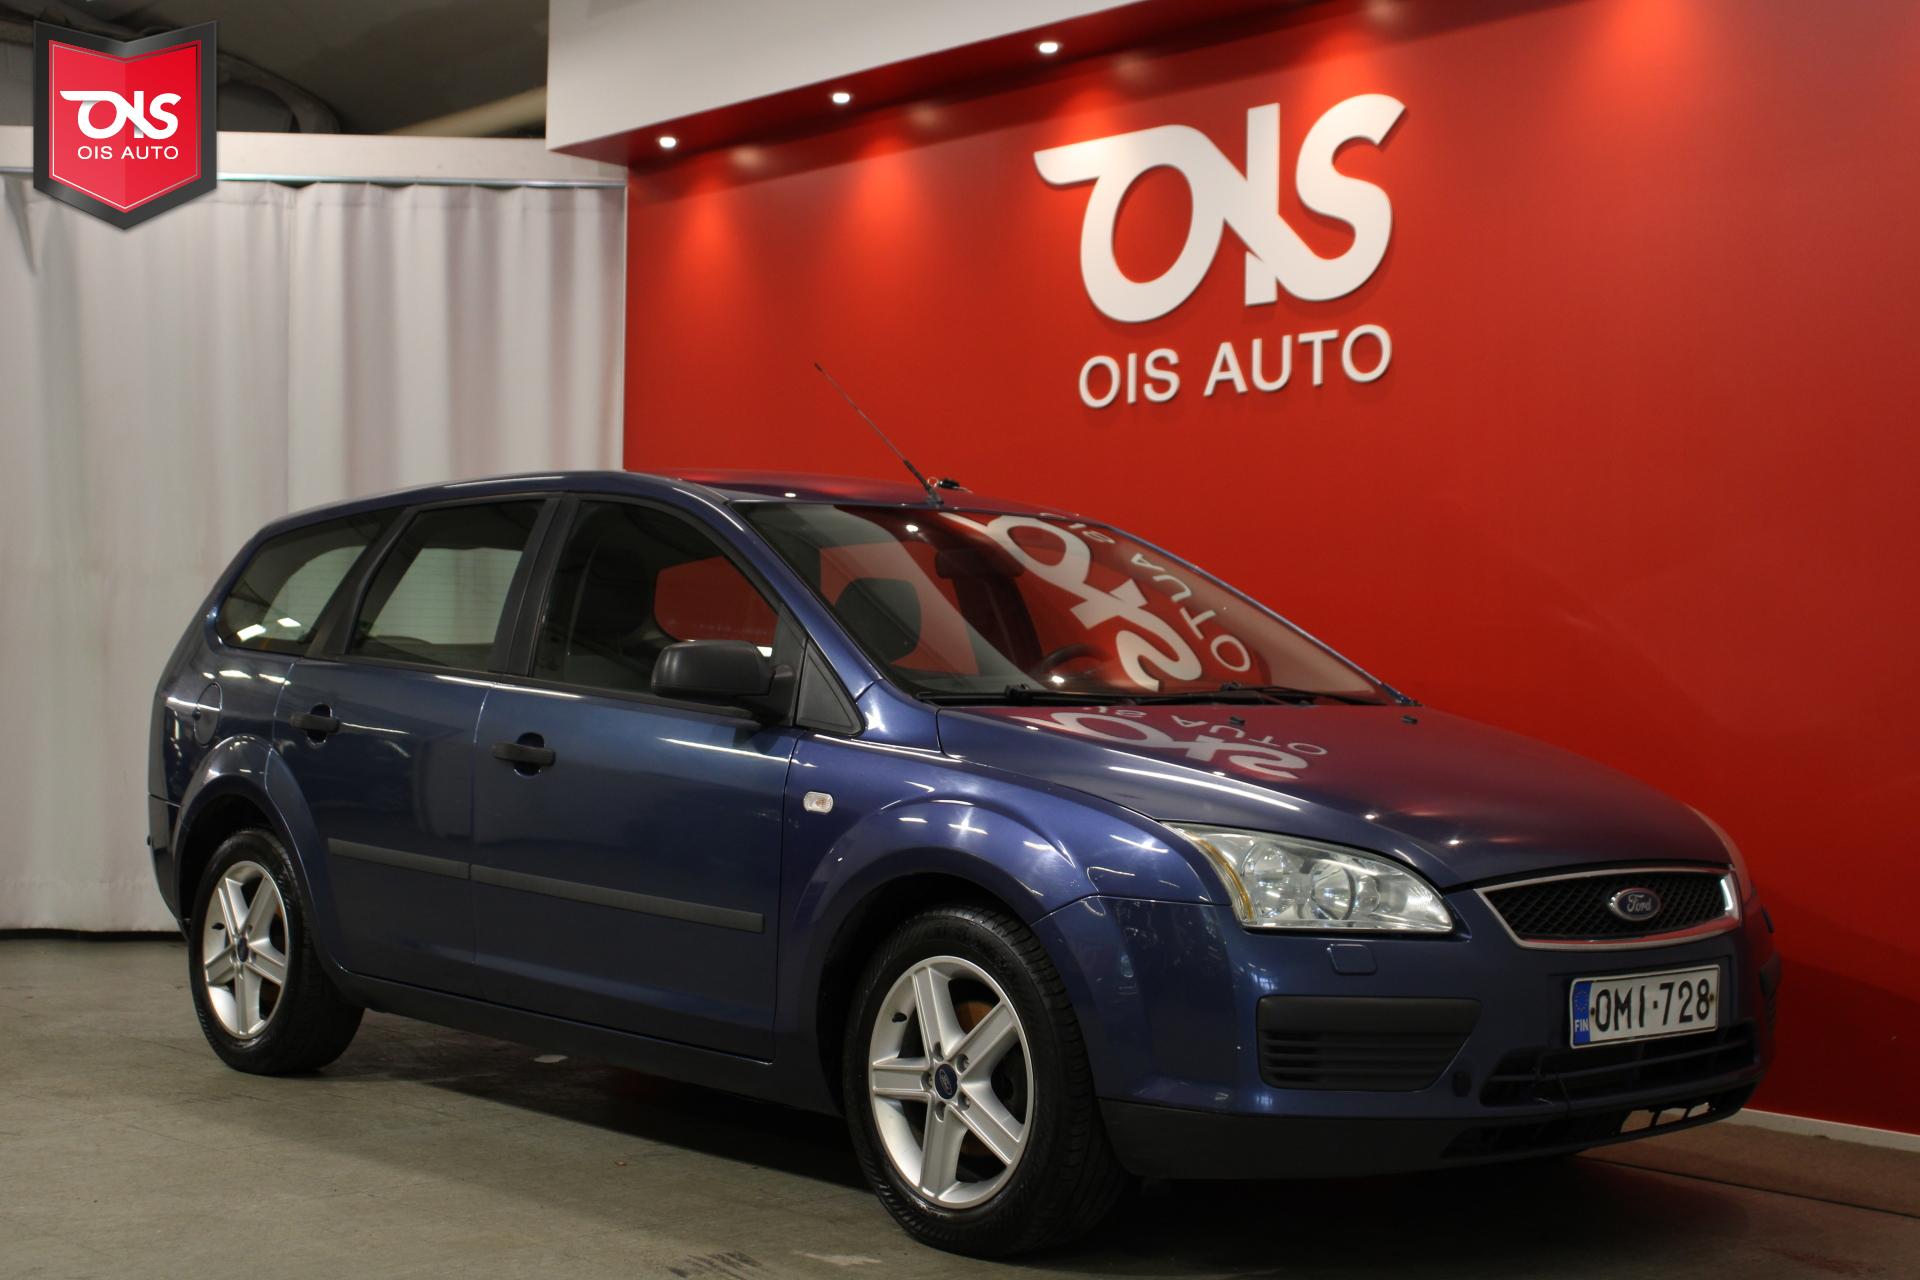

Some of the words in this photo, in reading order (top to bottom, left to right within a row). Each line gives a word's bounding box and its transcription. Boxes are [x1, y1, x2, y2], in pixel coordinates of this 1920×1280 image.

[1033, 93, 1405, 323] OIS
[1078, 347, 1181, 409] OIS
[1203, 323, 1393, 397] AUTO
[1626, 893, 1652, 912] Ford
[1574, 1018, 1589, 1033] FIN
